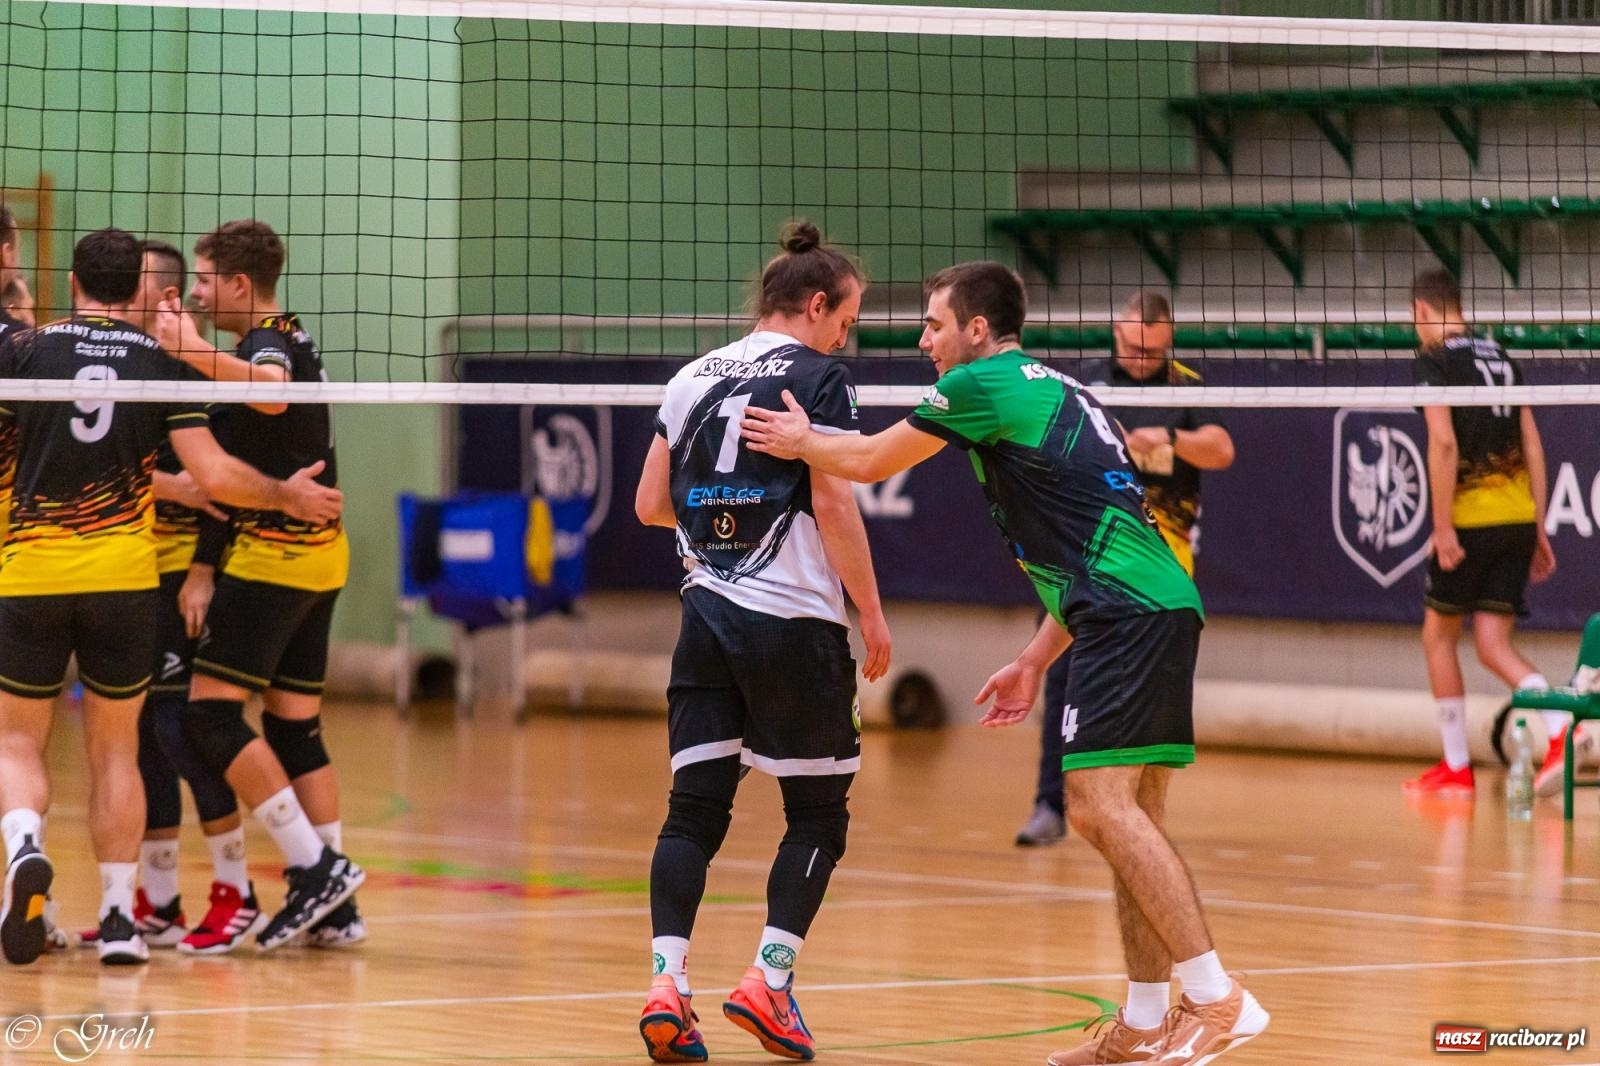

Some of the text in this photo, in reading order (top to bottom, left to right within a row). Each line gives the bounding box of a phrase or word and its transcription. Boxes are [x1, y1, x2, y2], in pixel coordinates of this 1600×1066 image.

[69, 364, 118, 443] 9
[706, 541, 733, 550] Studio
[1062, 704, 1079, 743] 4
